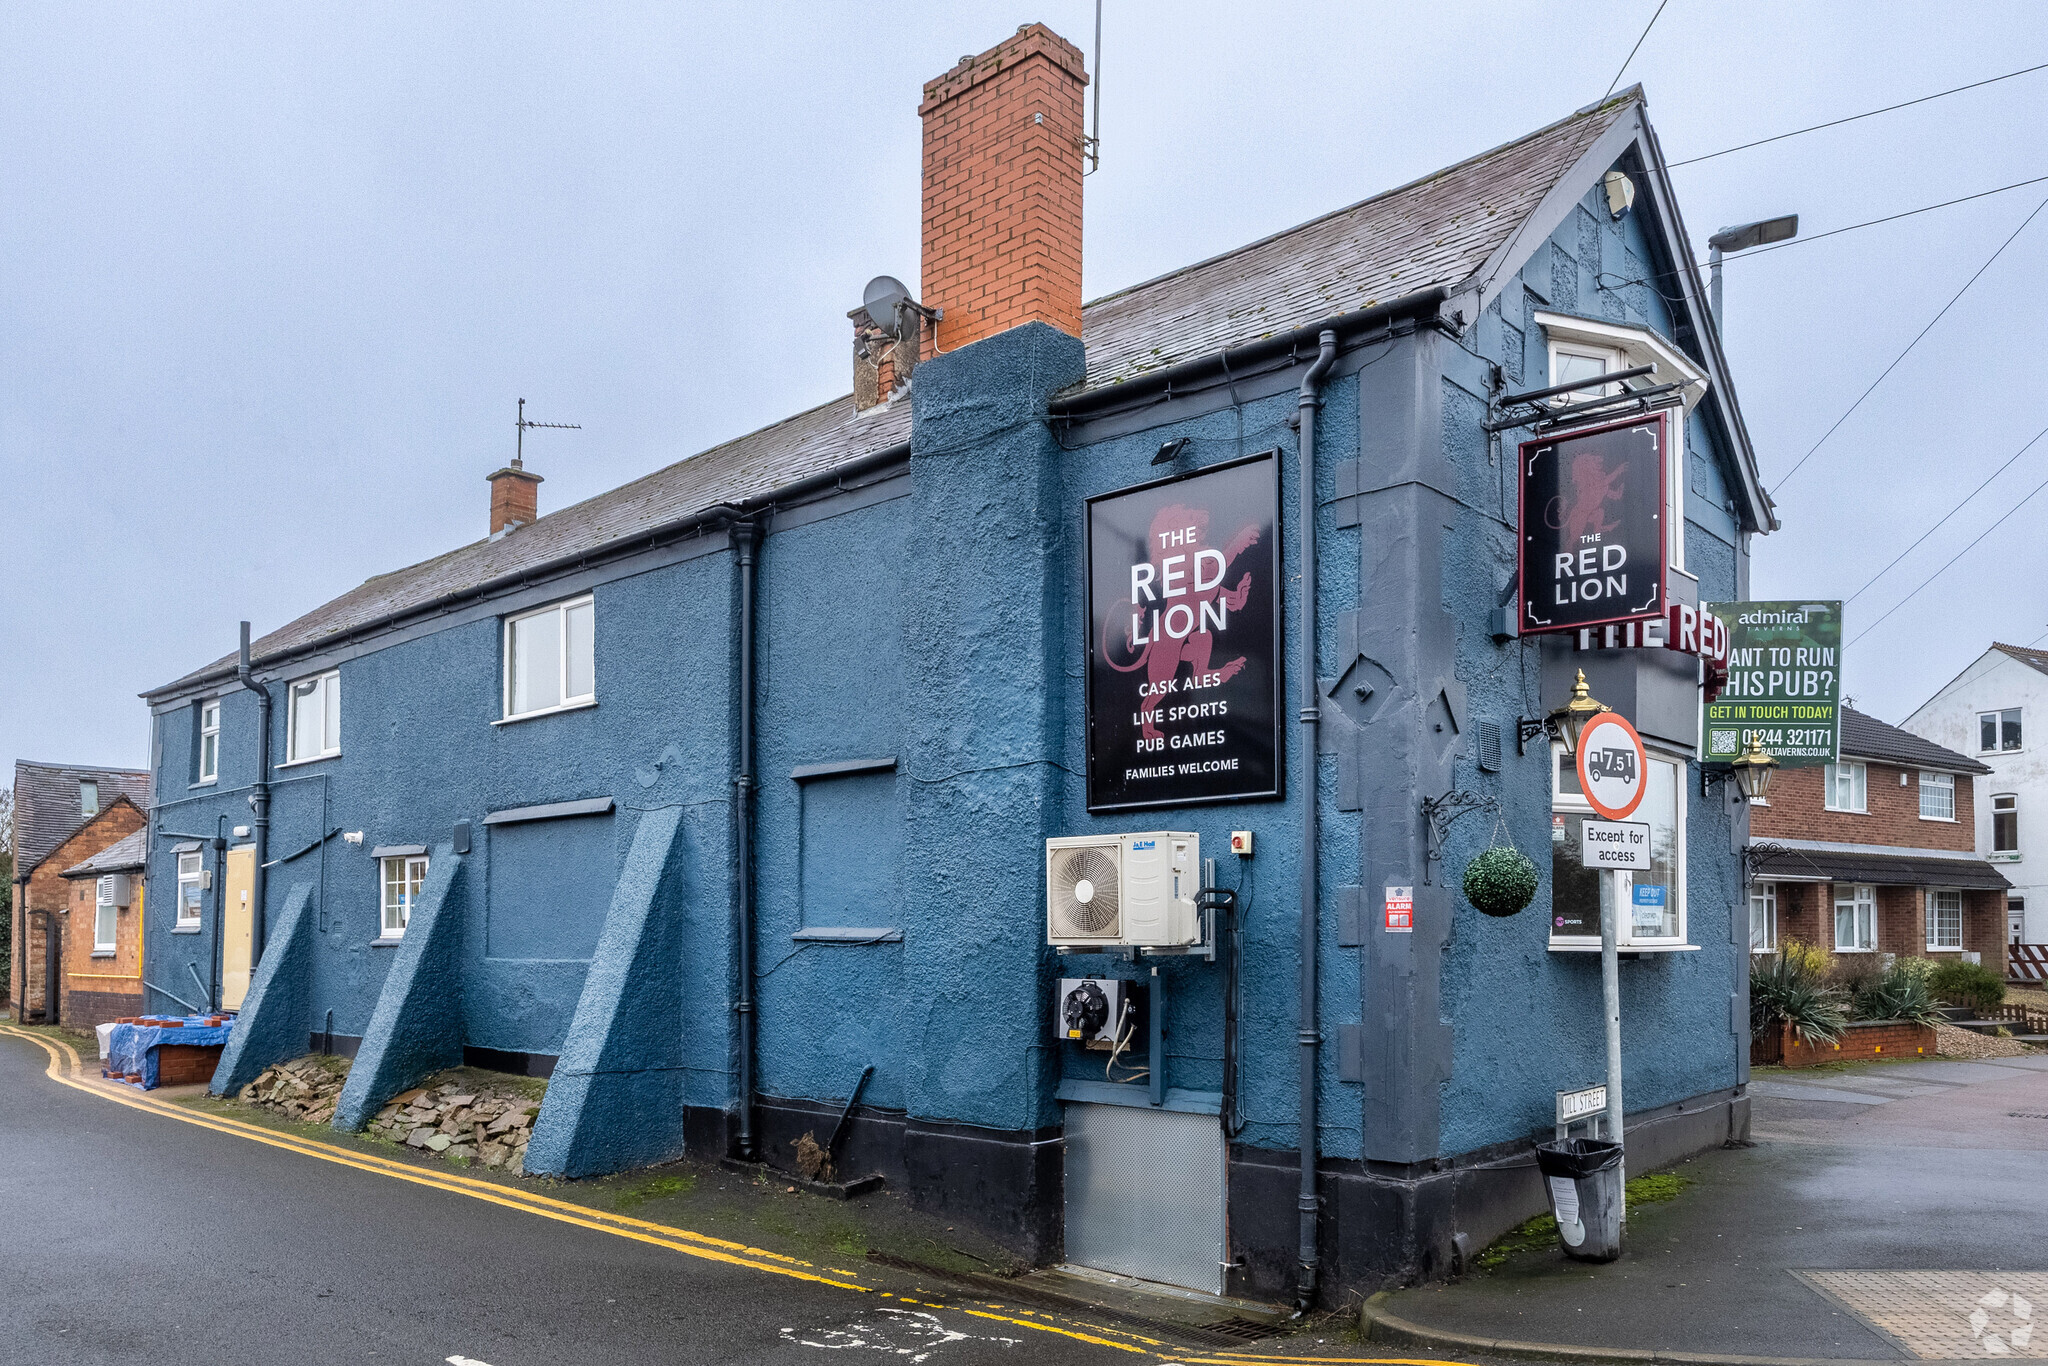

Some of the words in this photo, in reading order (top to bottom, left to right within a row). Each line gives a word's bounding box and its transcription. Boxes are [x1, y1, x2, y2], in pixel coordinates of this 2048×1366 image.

[1158, 526, 1197, 549] THE
[1580, 533, 1601, 543] THE
[1555, 544, 1627, 579] RED
[1131, 548, 1227, 605] RED
[1555, 573, 1627, 605] LION
[1132, 596, 1227, 646] LION
[1738, 609, 1809, 624] admiral
[1680, 603, 1726, 661] RED
[1729, 647, 1764, 667] ANT
[1769, 647, 1791, 667] TO
[1796, 647, 1834, 667] RUN
[1138, 677, 1179, 697] CASK
[1182, 673, 1221, 692] ALES
[1724, 671, 1765, 696] HIS
[1769, 670, 1834, 696] PUB?
[1133, 707, 1164, 726] LIVE
[1168, 701, 1228, 721] SPORTS
[1709, 706, 1732, 719] GET
[1735, 706, 1747, 719] IN
[1749, 706, 1788, 719] TOUCH
[1791, 706, 1833, 719] TODAY!
[1136, 735, 1165, 753] PUB
[1169, 730, 1225, 749] GAMES
[1786, 729, 1831, 746] 321171
[1125, 765, 1175, 780] FAMILIES
[1178, 758, 1239, 775] WELCOME
[1588, 827, 1625, 844] Except
[1629, 830, 1644, 844] for
[1598, 850, 1636, 862] access
[1639, 887, 1651, 897] KEEP
[1650, 888, 1661, 897] OUT
[1580, 1090, 1604, 1110] STREET
